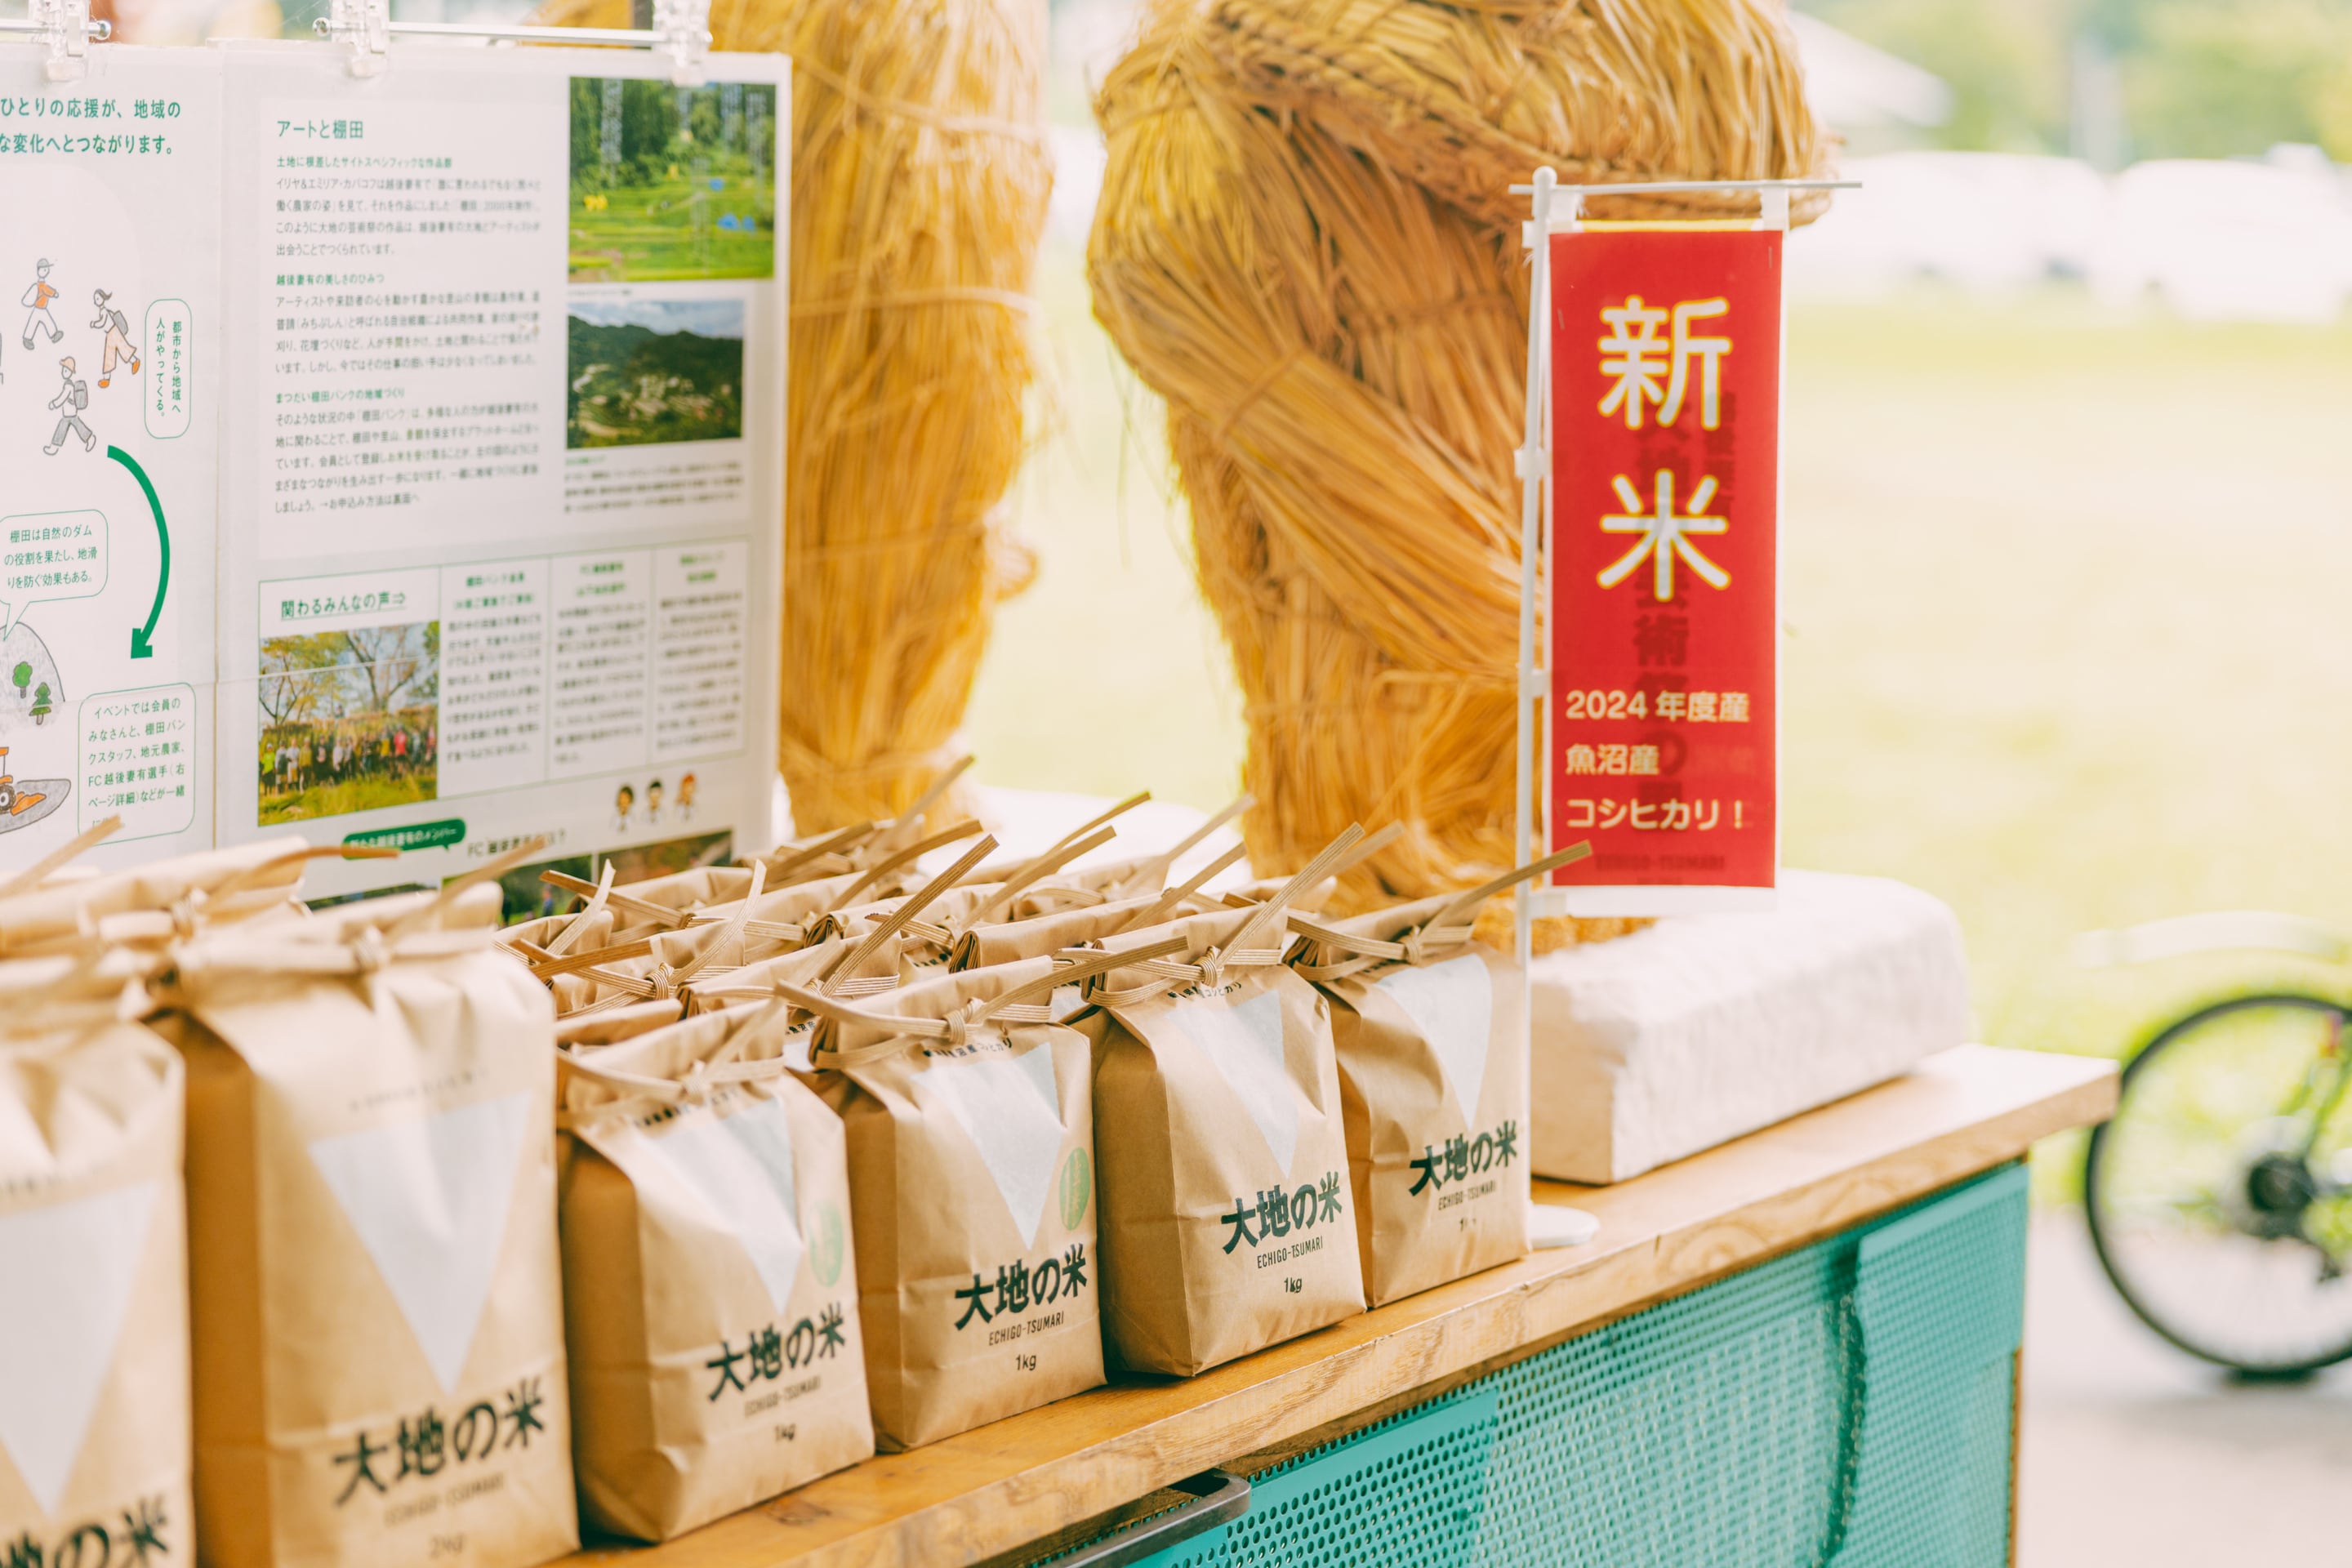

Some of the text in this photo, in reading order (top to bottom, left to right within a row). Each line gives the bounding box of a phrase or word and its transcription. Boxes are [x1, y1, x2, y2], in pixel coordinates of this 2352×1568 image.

[1, 97, 181, 119] ひとりの応援が、地域の
[0, 133, 172, 154] な変化へとつながります。
[277, 120, 363, 139] アートと棚田
[156, 317, 165, 417] 人がやってくる。
[172, 321, 182, 413] 都市から地域へ
[1597, 295, 1732, 602] 新米
[10, 523, 92, 543] 棚田は自然のダム
[95, 697, 181, 719] イベントでは会員の
[1566, 690, 1749, 722] 2024 年度産
[1566, 743, 1659, 776] 魚沼産
[1567, 797, 1744, 831] コシヒカリ！
[1408, 1120, 1517, 1196] 大地の米
[1220, 1171, 1343, 1255] 大地の米
[1257, 1236, 1323, 1269] ECHIGO-TSUMARI
[954, 1243, 1087, 1331] 大地の米
[1284, 1277, 1303, 1294] 1kg
[988, 1311, 1064, 1346] ECHIGO-TSUMARI
[706, 1300, 845, 1402] 大地の米
[1016, 1354, 1036, 1371] 1kg
[332, 1376, 543, 1508] 大地の米
